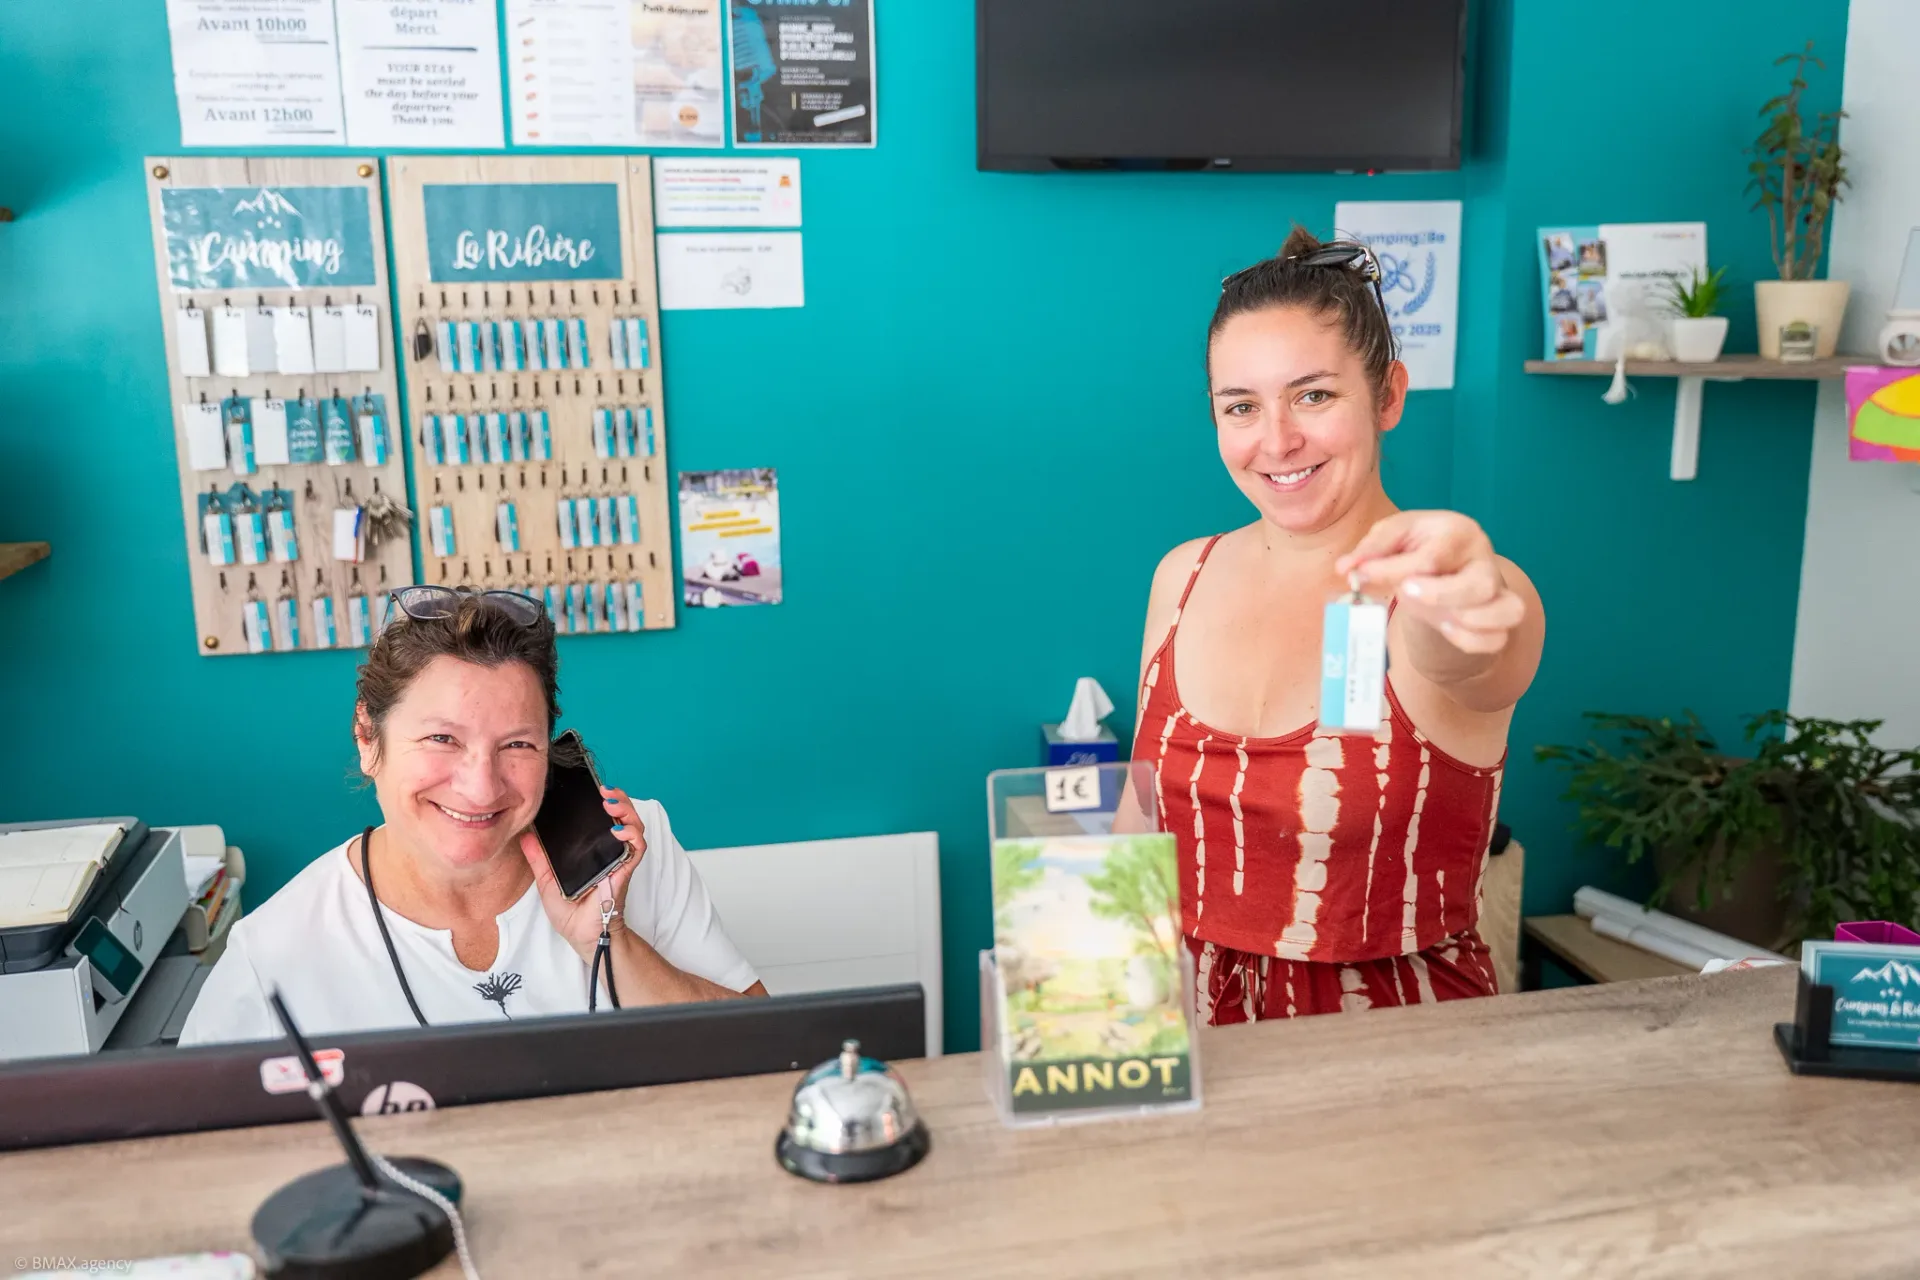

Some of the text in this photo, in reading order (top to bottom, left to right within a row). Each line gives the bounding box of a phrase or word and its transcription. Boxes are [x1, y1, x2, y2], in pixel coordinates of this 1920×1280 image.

[197, 17, 307, 32] Avant 10h00
[204, 108, 314, 122] Avant 12h00
[199, 230, 344, 276] Camping
[452, 224, 596, 271] La Ribière
[1012, 1057, 1180, 1097] ANNOT
